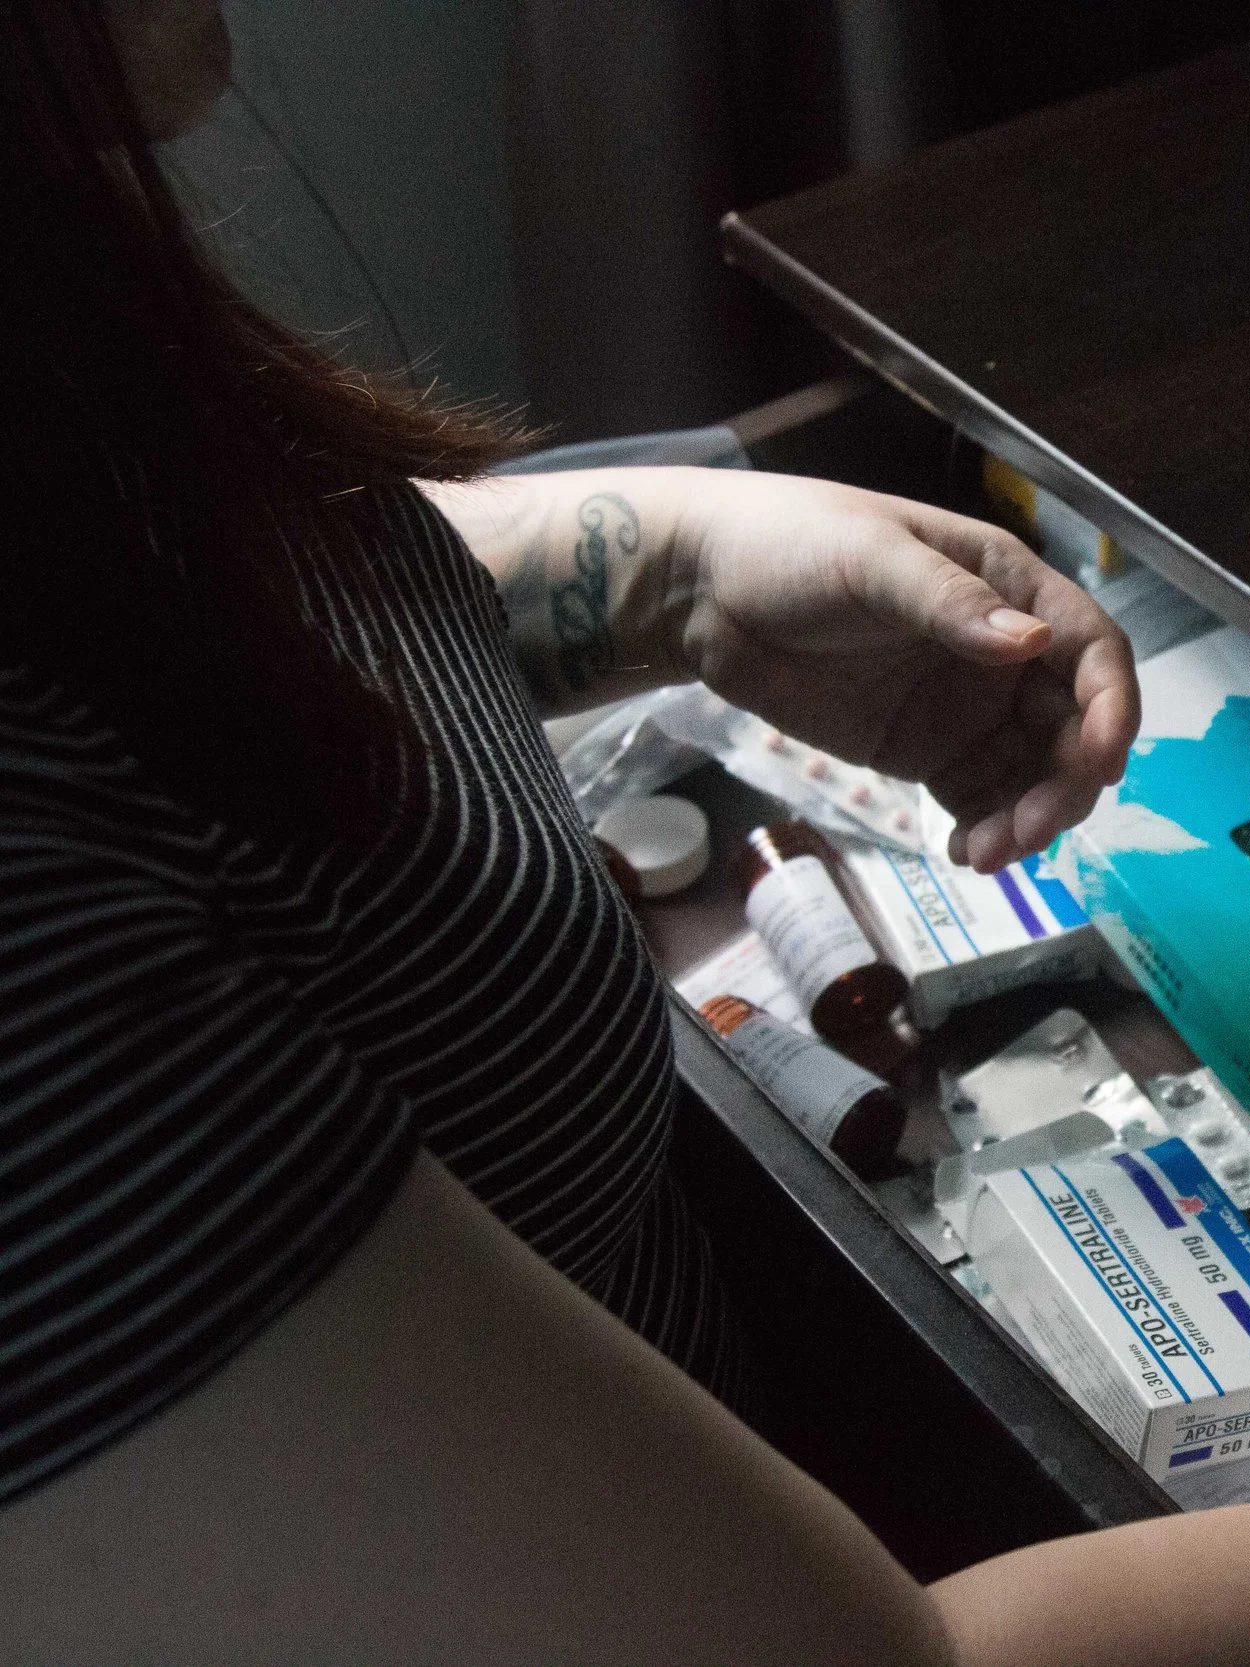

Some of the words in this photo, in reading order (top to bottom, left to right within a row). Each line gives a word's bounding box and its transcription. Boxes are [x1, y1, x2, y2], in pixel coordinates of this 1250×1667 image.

[1086, 1188, 1117, 1225] Tablets
[1182, 1236, 1211, 1260] mg
[1049, 1193, 1188, 1358] APO-SERTRALINE
[1113, 1227, 1172, 1301] Hydrochloride
[1199, 1264, 1228, 1284] 50
[1168, 1301, 1215, 1356] Sertraline
[1142, 1372, 1163, 1388] 30
[1219, 1440, 1243, 1456] 50
